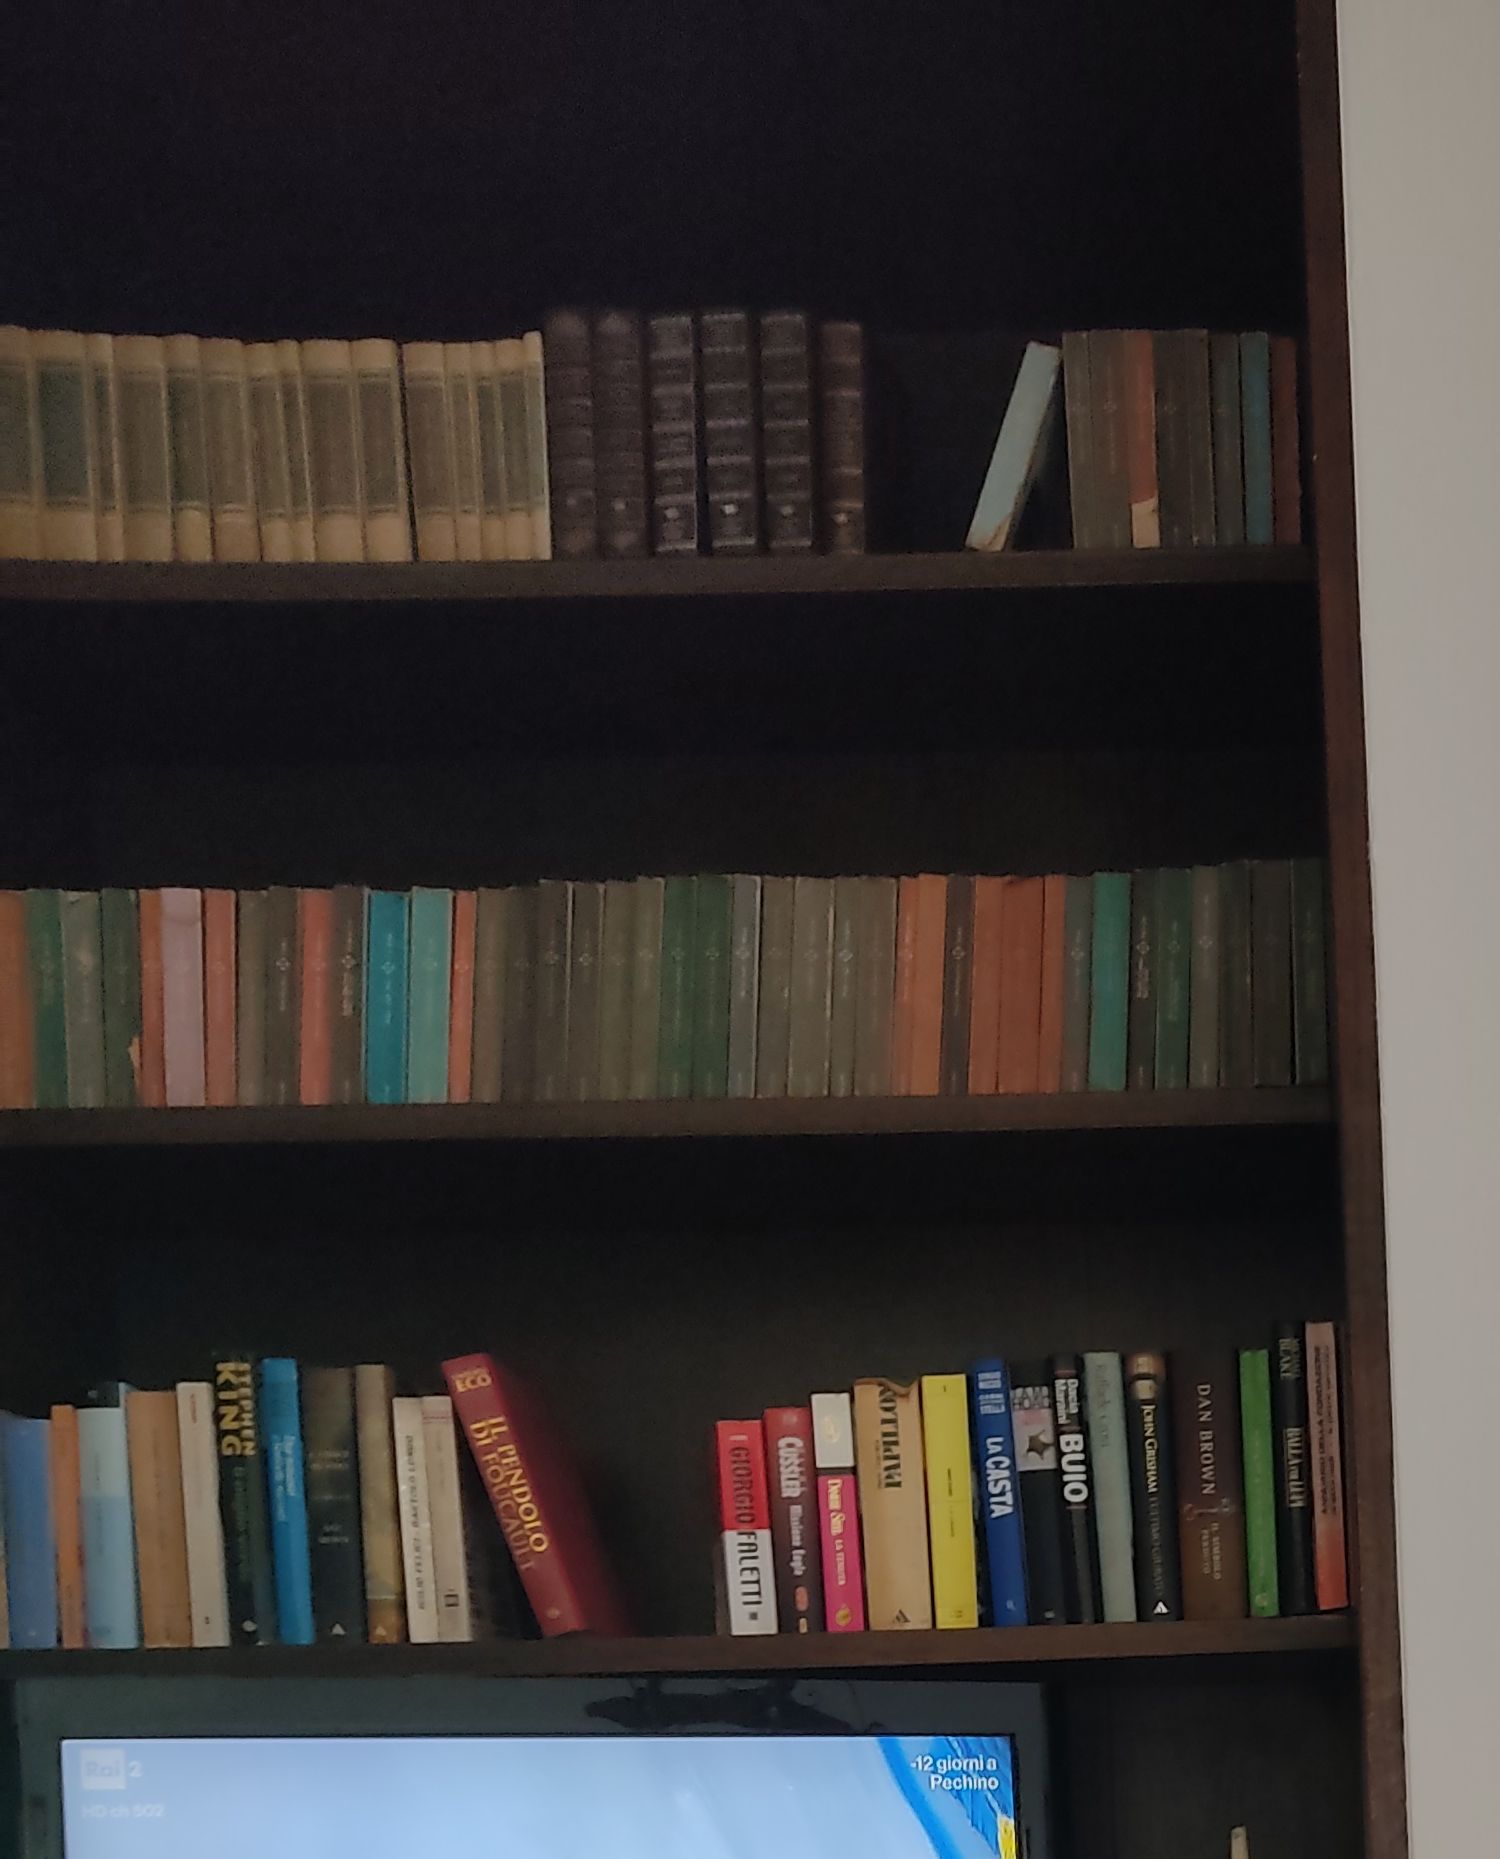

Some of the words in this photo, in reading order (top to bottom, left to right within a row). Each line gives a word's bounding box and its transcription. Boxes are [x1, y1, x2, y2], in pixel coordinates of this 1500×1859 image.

[455, 1374, 492, 1393] ECO
[1054, 1378, 1070, 1424] Maraini
[1066, 1378, 1080, 1414] Dacia
[1196, 1383, 1214, 1423] DAN
[216, 1362, 241, 1456] KING
[470, 1420, 492, 1448] DI
[487, 1414, 510, 1440] IL
[1140, 1405, 1156, 1437] JOHN
[729, 1446, 756, 1524] GIORGIO
[778, 1437, 804, 1498] CUSSLER
[1059, 1433, 1089, 1503] BUIO
[1145, 1438, 1159, 1493] GRISHAM
[1198, 1429, 1217, 1495] BROWN
[480, 1451, 536, 1572] FOUCAULT
[498, 1442, 552, 1553] PENDOLO
[985, 1456, 1015, 1519] CASTA
[736, 1531, 763, 1606] FALETTI
[85, 1761, 120, 1777] Rai
[128, 1761, 142, 1777] 2
[910, 1756, 934, 1771] -12
[937, 1755, 984, 1774] giorni
[987, 1758, 997, 1771] a
[930, 1774, 999, 1791] Pechino
